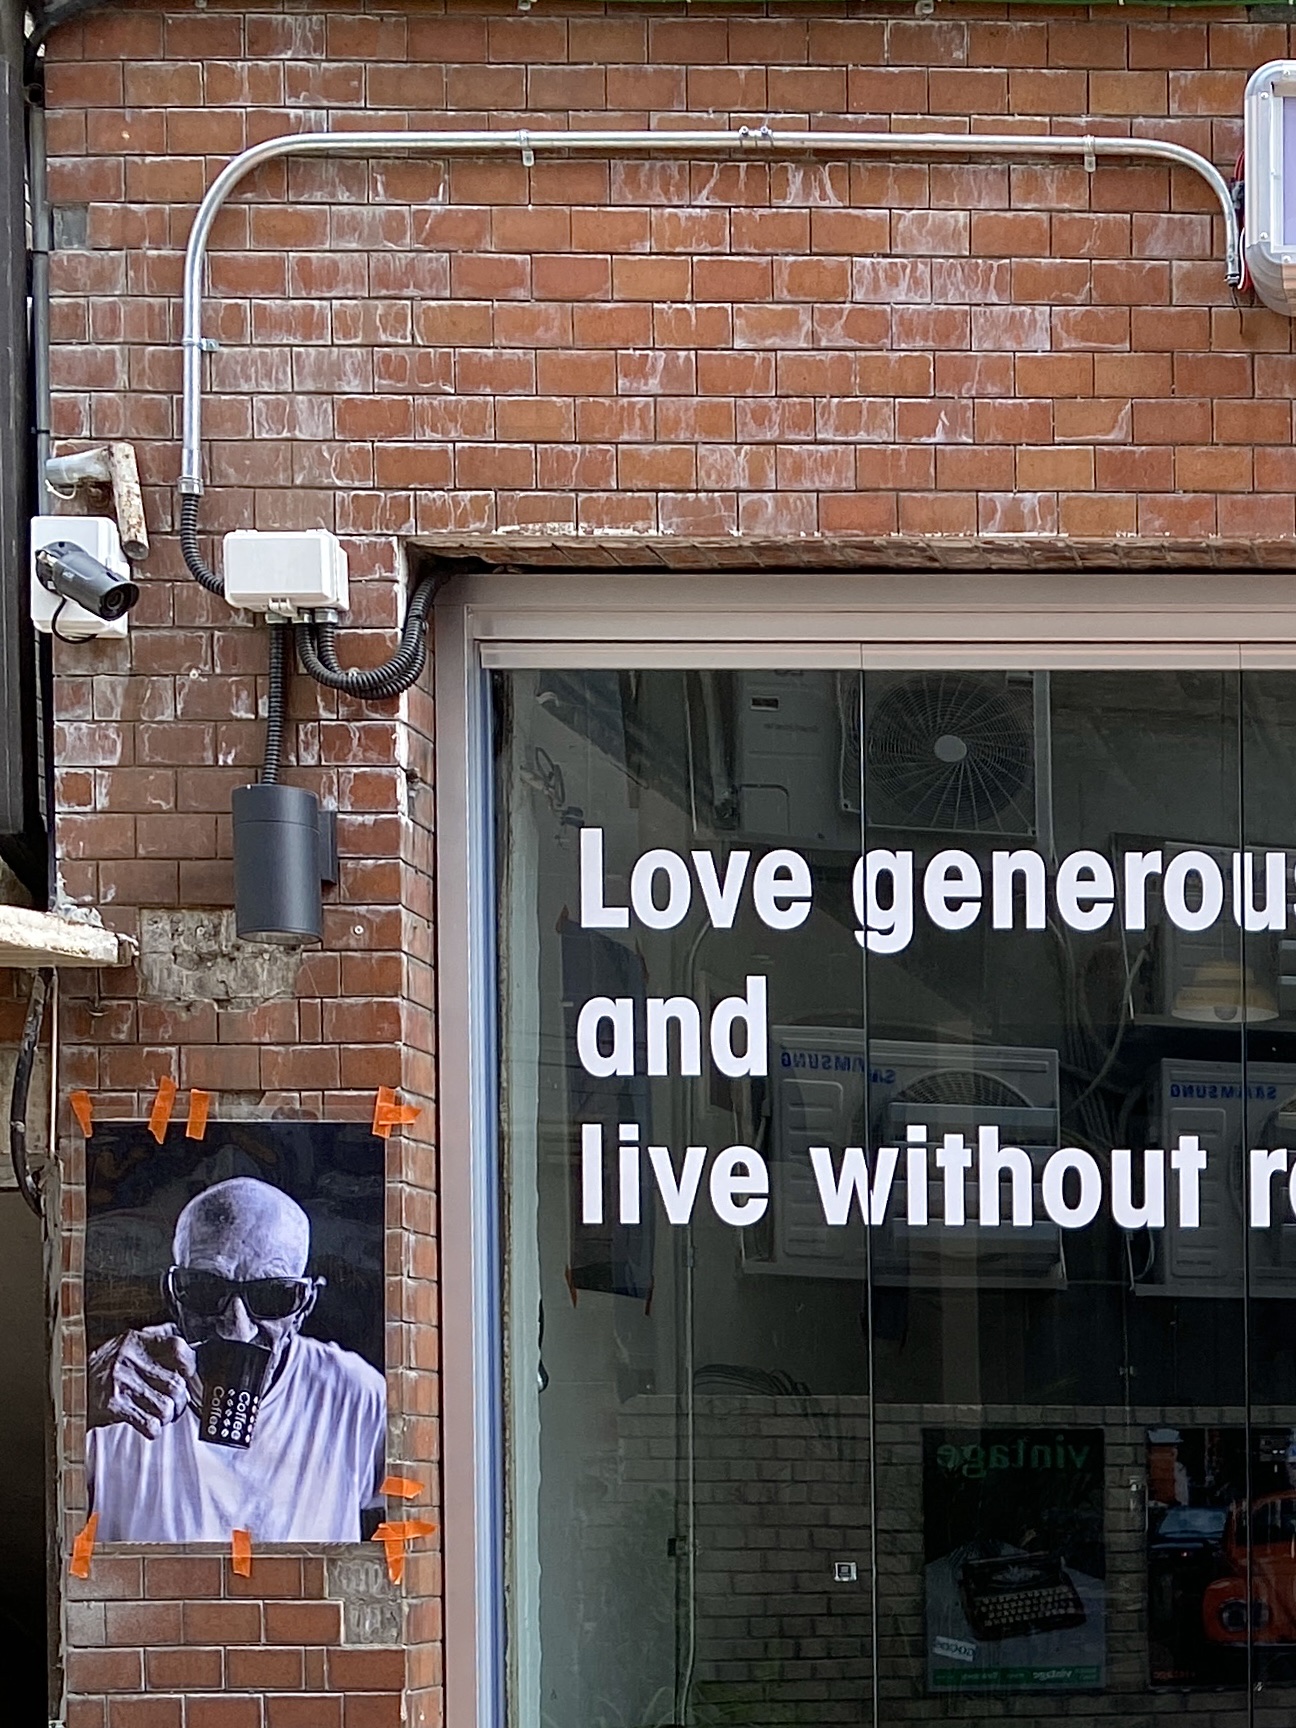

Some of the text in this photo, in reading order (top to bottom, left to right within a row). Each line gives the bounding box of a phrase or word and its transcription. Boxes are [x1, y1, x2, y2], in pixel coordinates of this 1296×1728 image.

[578, 828, 812, 932] Love
[576, 975, 769, 1078] and
[581, 1124, 770, 1228] live
[809, 1124, 1208, 1230] without
[208, 1386, 225, 1435] Coffee
[231, 1391, 251, 1440] Coffee
